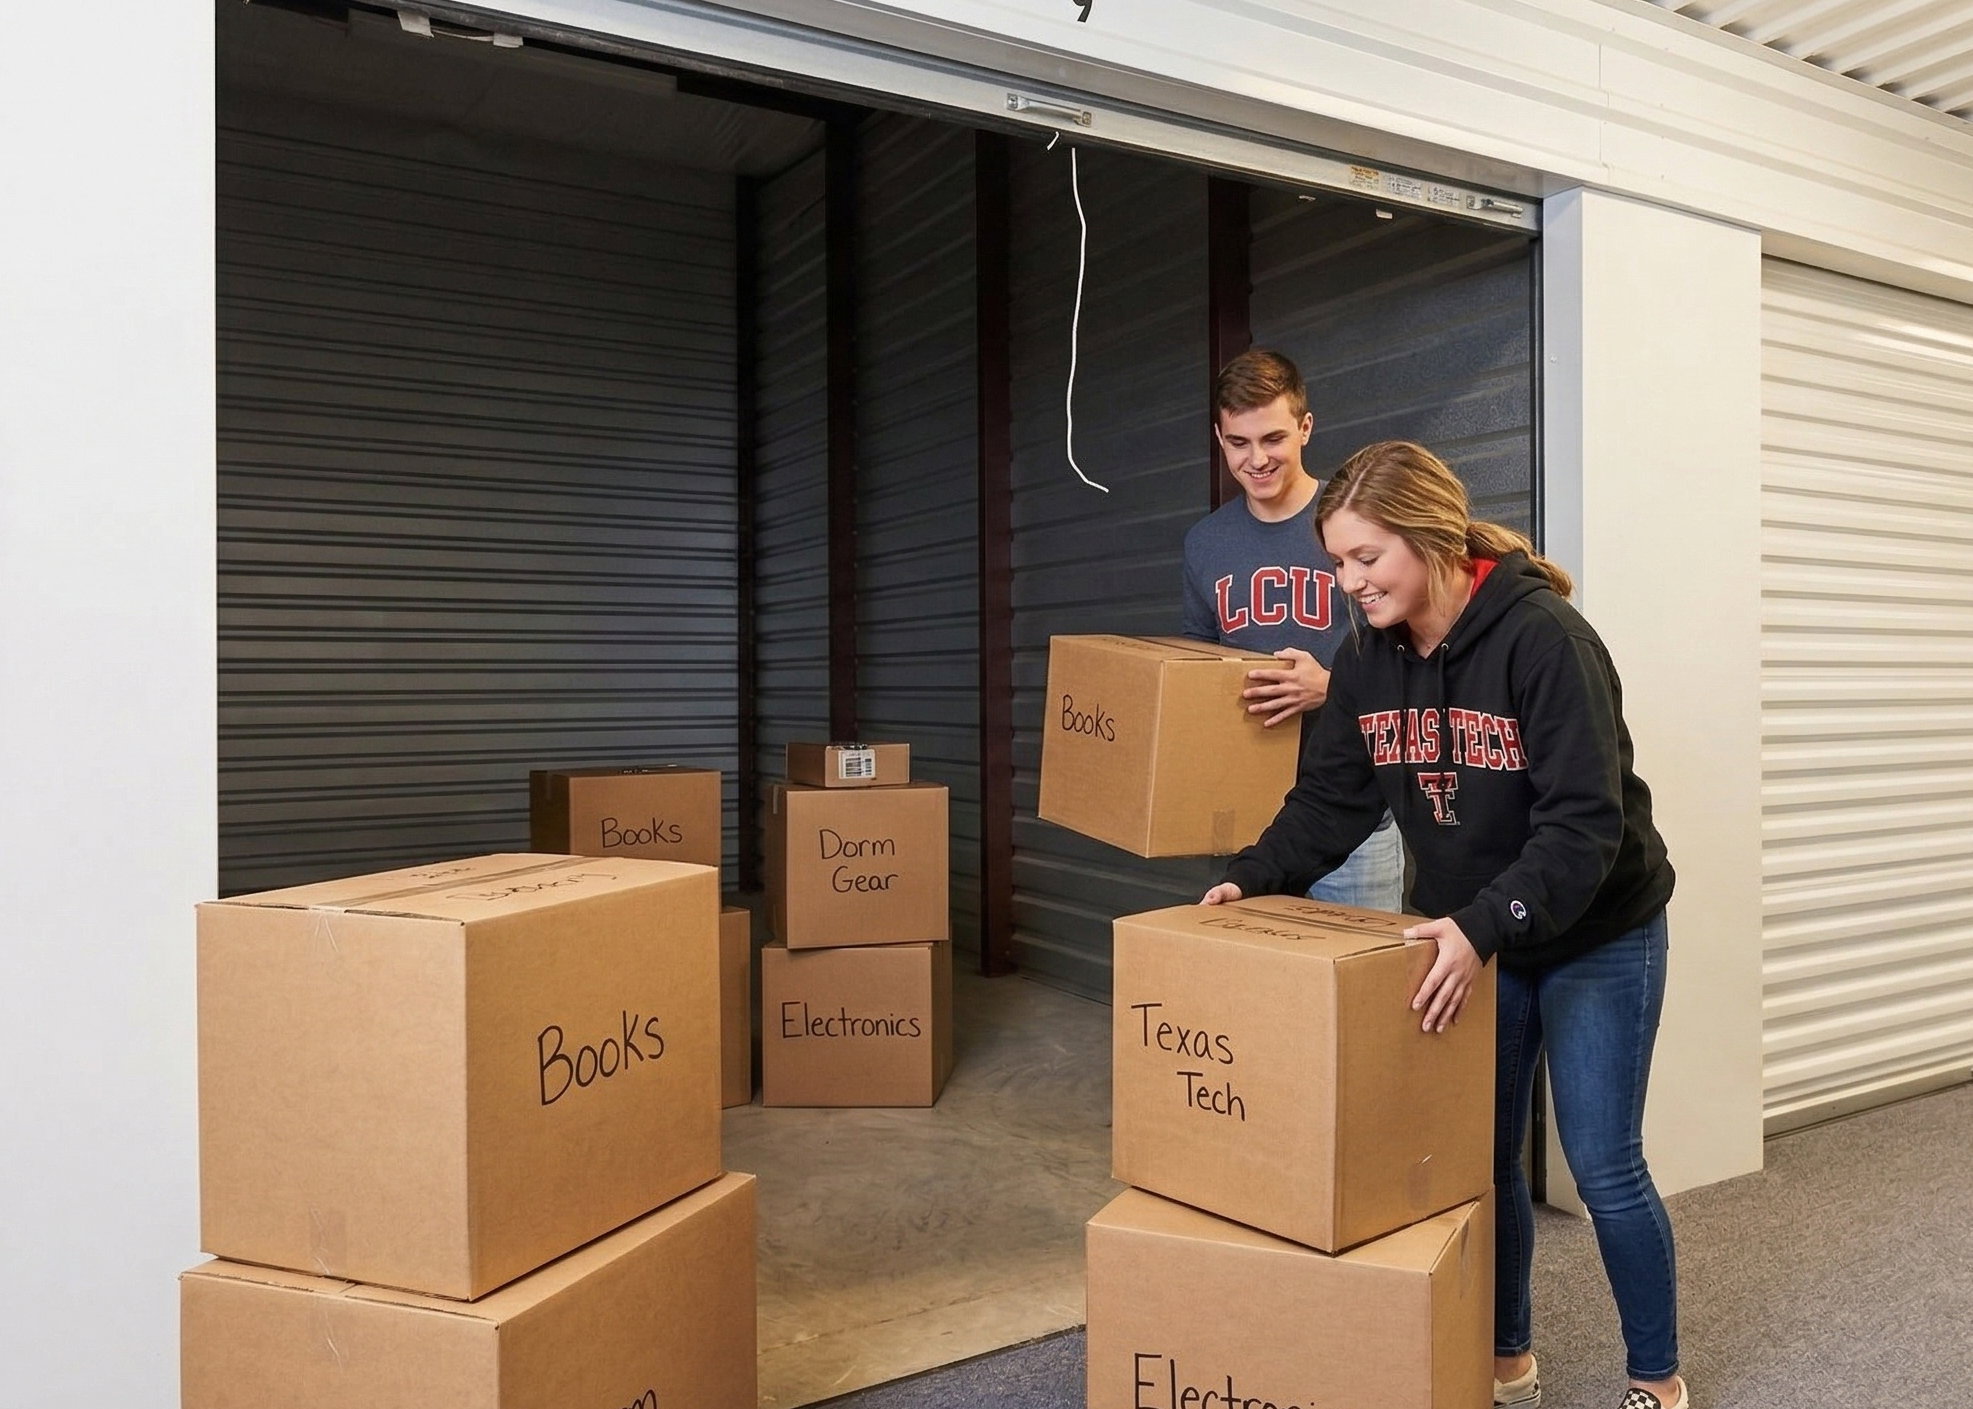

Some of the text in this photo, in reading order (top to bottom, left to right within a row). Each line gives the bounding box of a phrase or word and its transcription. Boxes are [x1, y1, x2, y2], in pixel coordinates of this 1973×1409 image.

[1215, 566, 1336, 634] LCU
[1061, 694, 1116, 742] Books
[1358, 707, 1530, 771] TEXAS TECH
[601, 817, 683, 849] Books
[819, 829, 896, 860] Dorm
[832, 866, 899, 893] Gear
[781, 1001, 922, 1039] Electronics
[1131, 1002, 1234, 1065] Texas
[537, 1010, 665, 1106] Books
[1177, 1071, 1245, 1122] Tech
